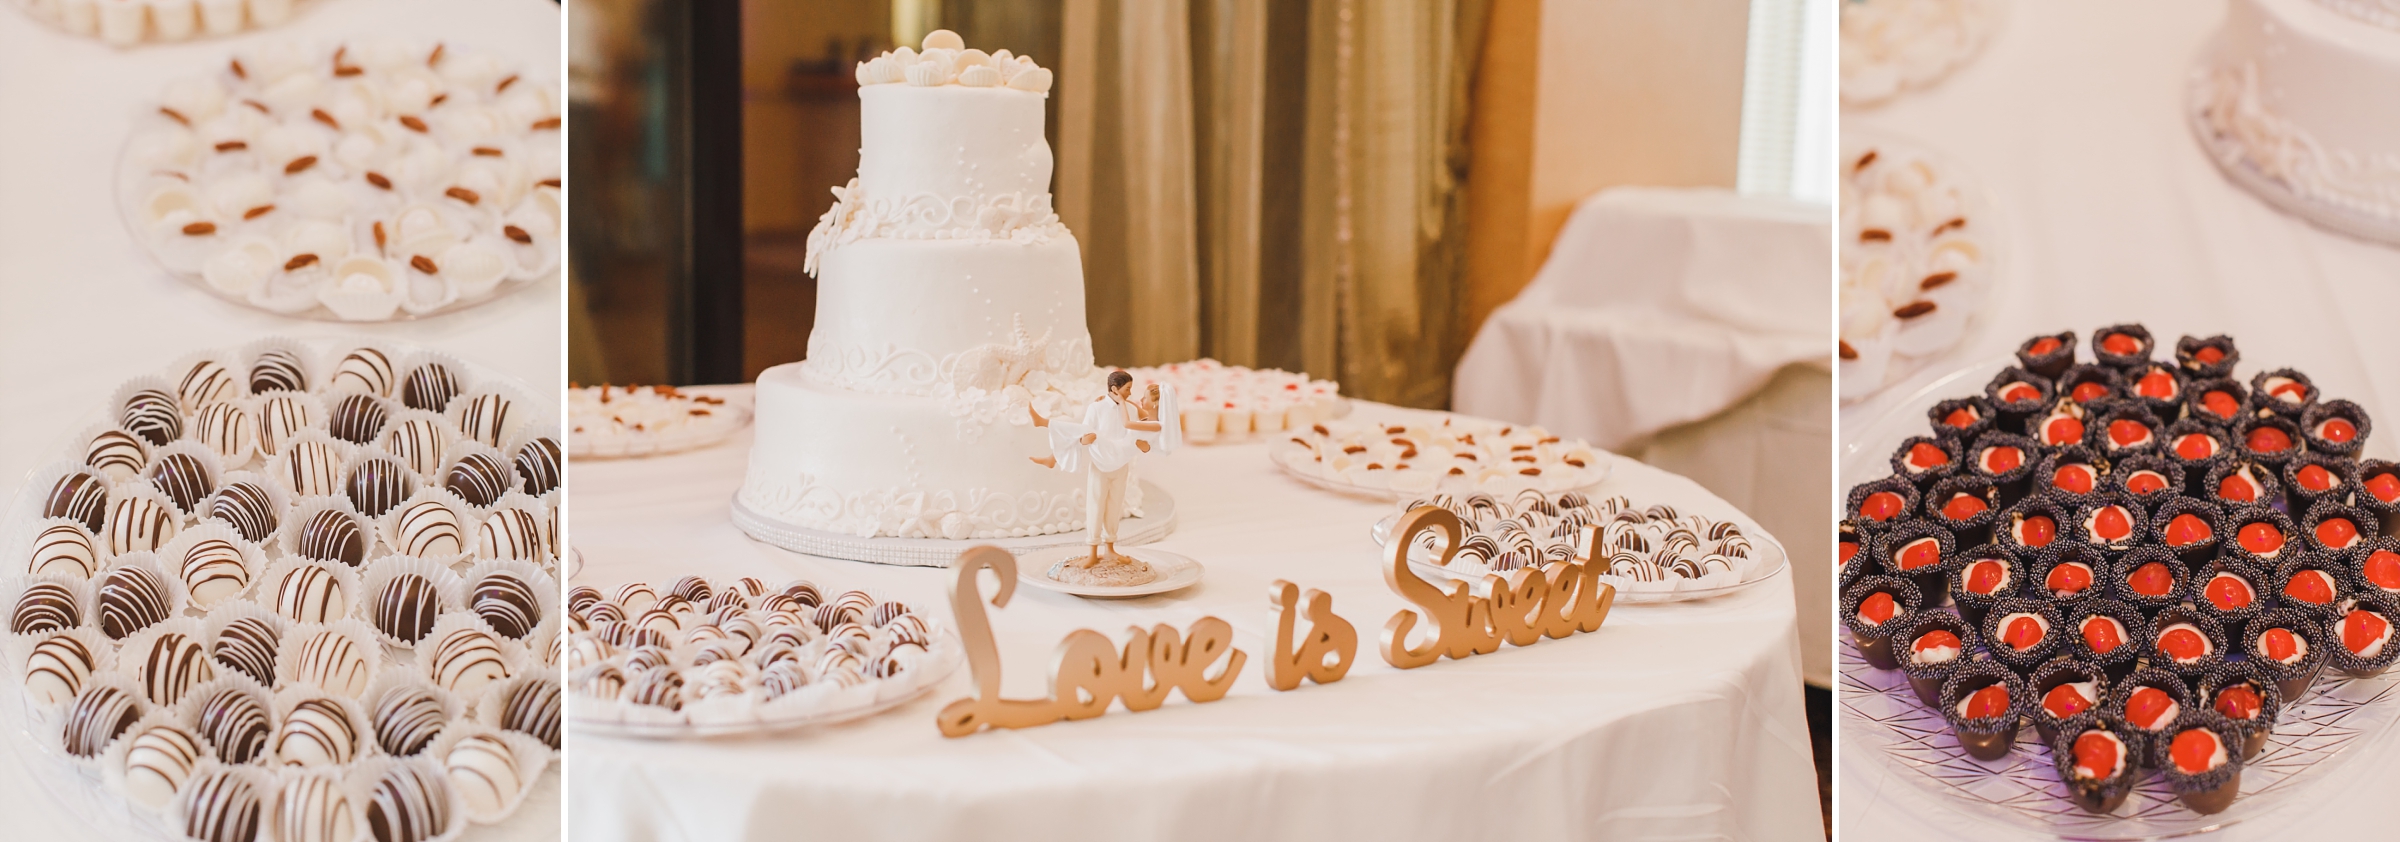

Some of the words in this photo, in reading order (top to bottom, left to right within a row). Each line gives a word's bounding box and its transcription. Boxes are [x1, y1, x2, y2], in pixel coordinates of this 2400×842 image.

[936, 545, 1247, 738] Love
[1264, 579, 1358, 692] is
[1380, 505, 1615, 670] Sweet
